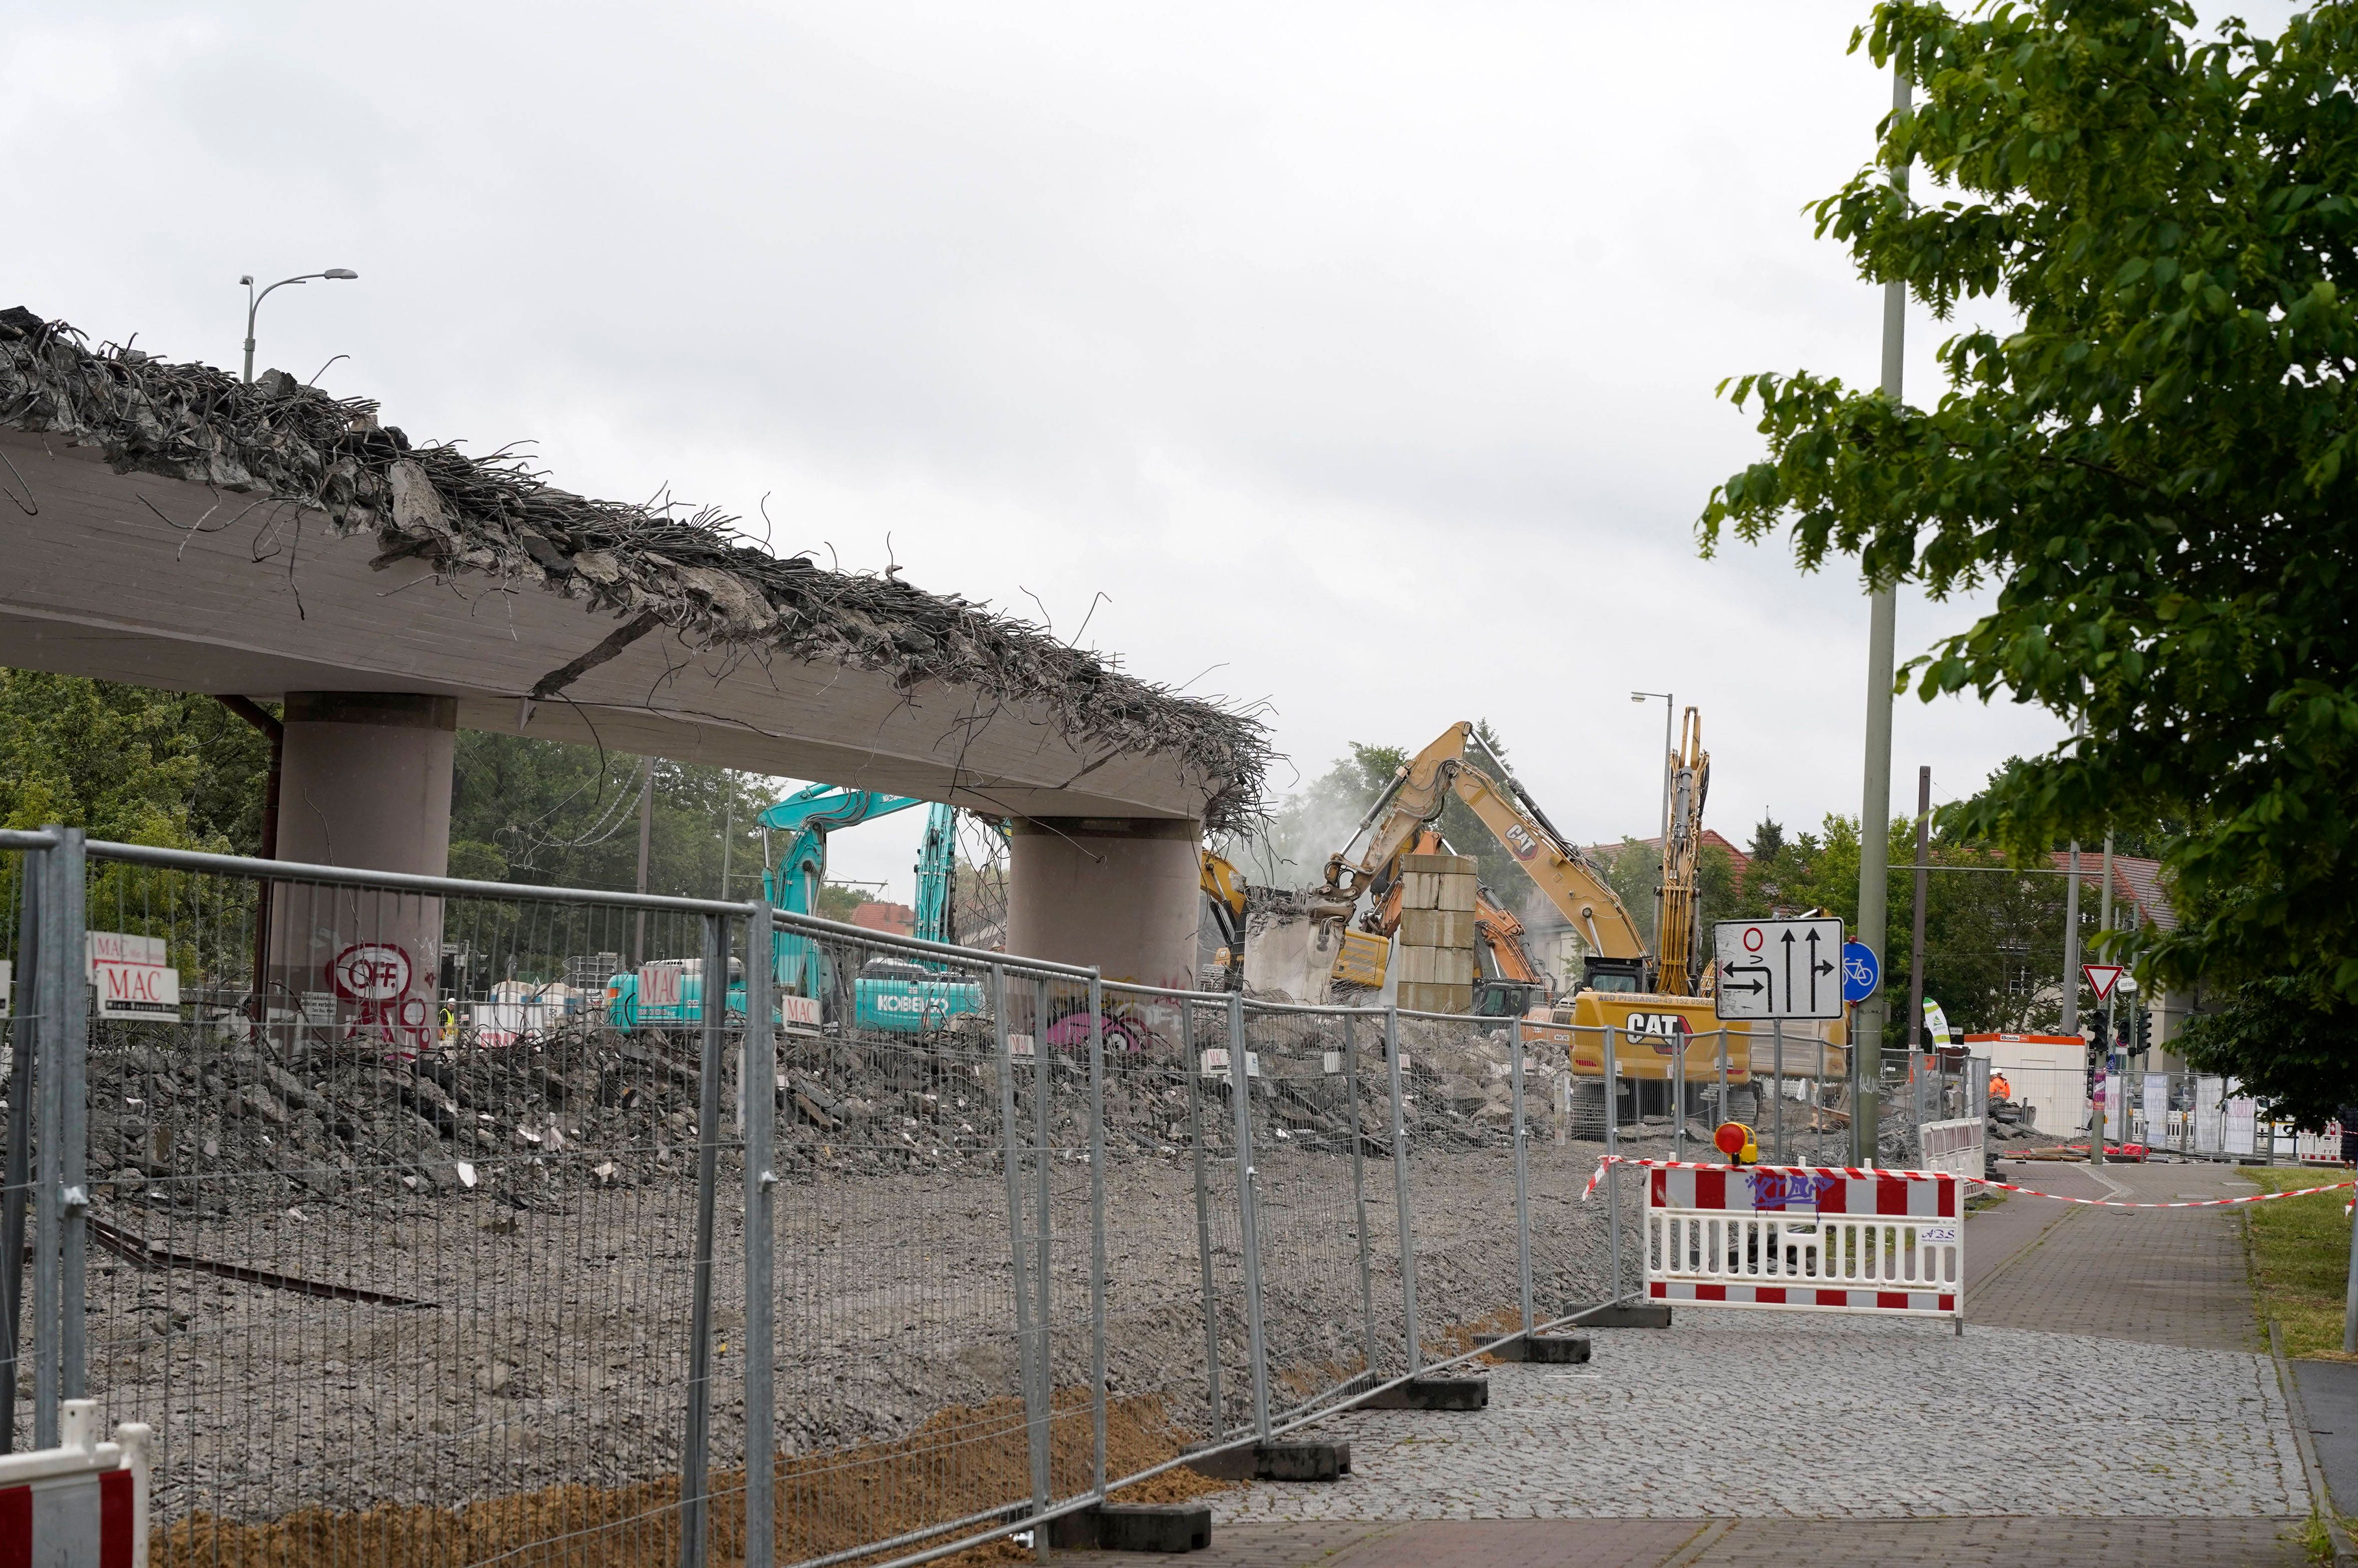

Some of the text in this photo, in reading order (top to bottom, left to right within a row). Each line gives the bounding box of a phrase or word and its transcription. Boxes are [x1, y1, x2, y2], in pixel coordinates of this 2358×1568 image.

[1506, 823, 1536, 853] CAT
[98, 938, 128, 958] MAC
[108, 969, 161, 1001] MAC
[640, 969, 680, 1003] MAC
[787, 999, 814, 1023] MAC
[1628, 1013, 1678, 1045] CAT
[1209, 1050, 1222, 1064] MAC
[1922, 1229, 1954, 1239] ABS
